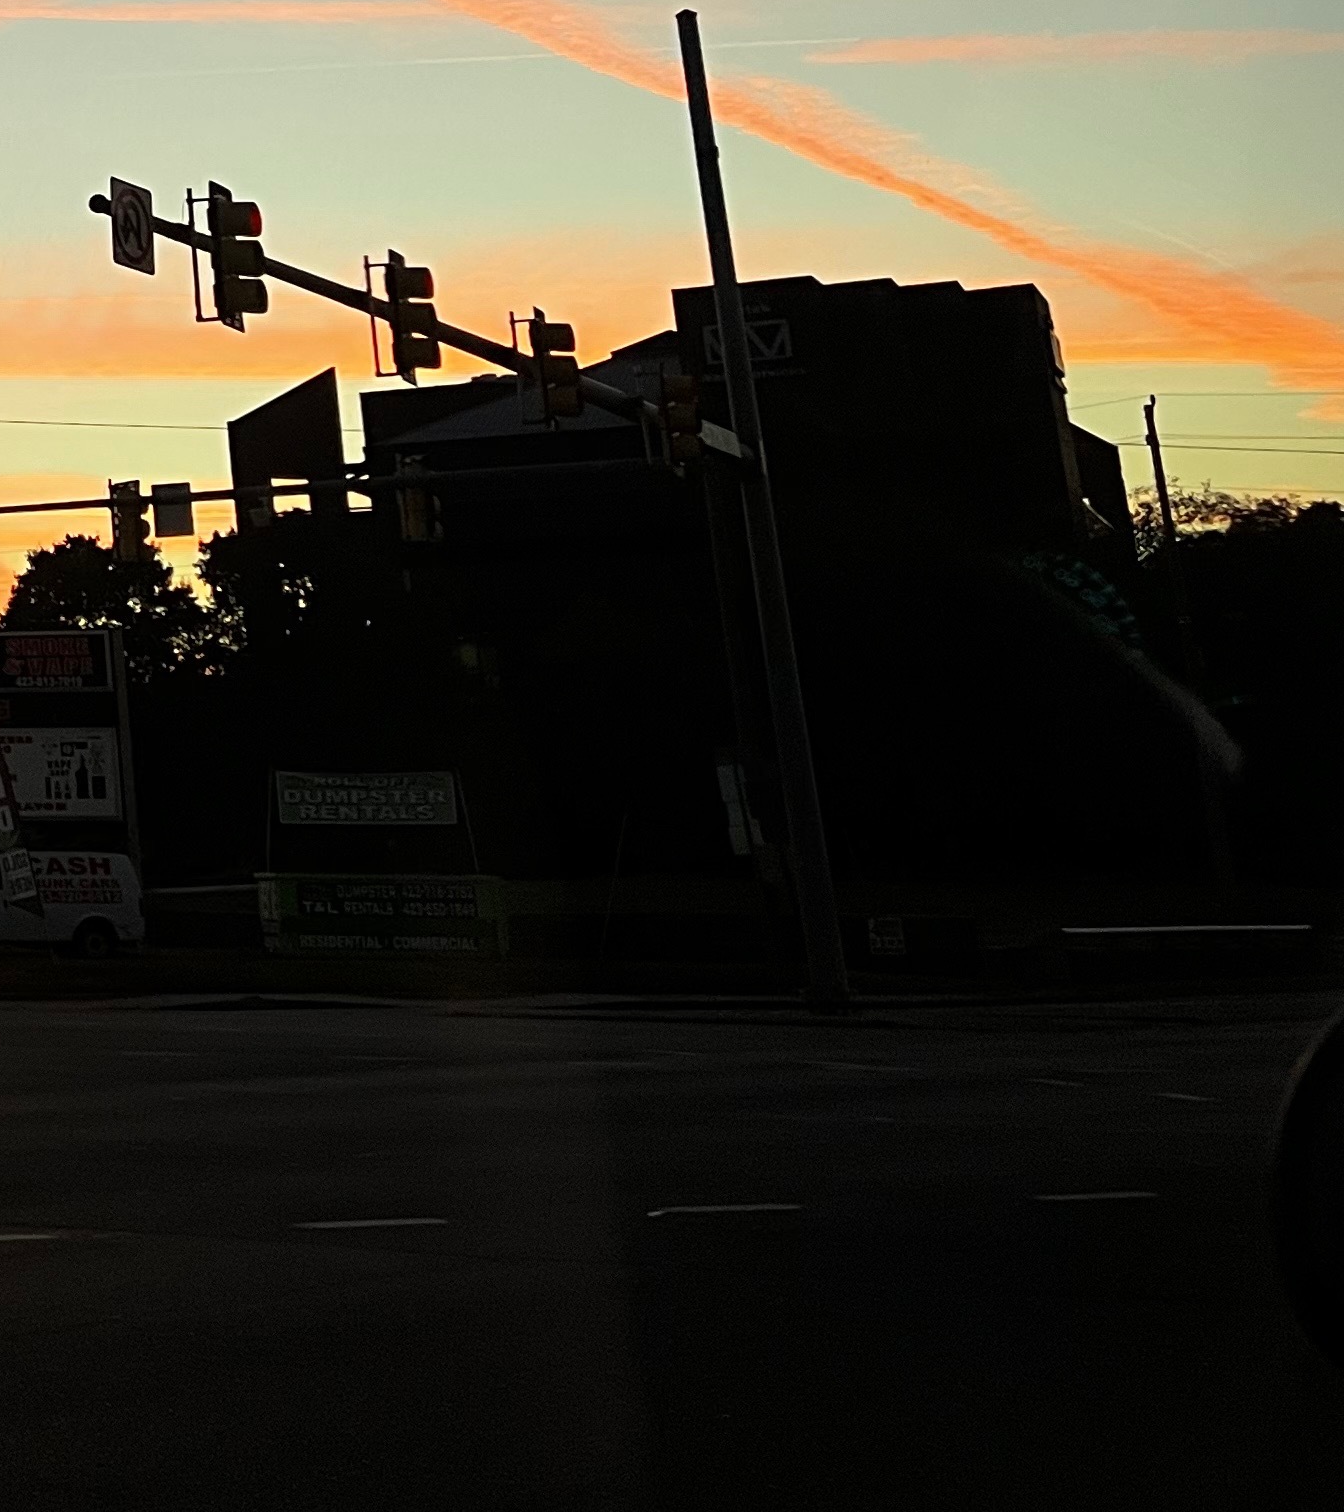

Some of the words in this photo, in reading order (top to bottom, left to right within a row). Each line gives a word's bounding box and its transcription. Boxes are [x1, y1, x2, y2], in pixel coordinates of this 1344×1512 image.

[5, 637, 90, 656] SMOKE
[283, 789, 447, 804] DUMPSTER
[299, 805, 435, 820] RENTALS
[299, 934, 383, 951] RESIDENTIAL
[392, 935, 479, 952] COMMERCIAL
